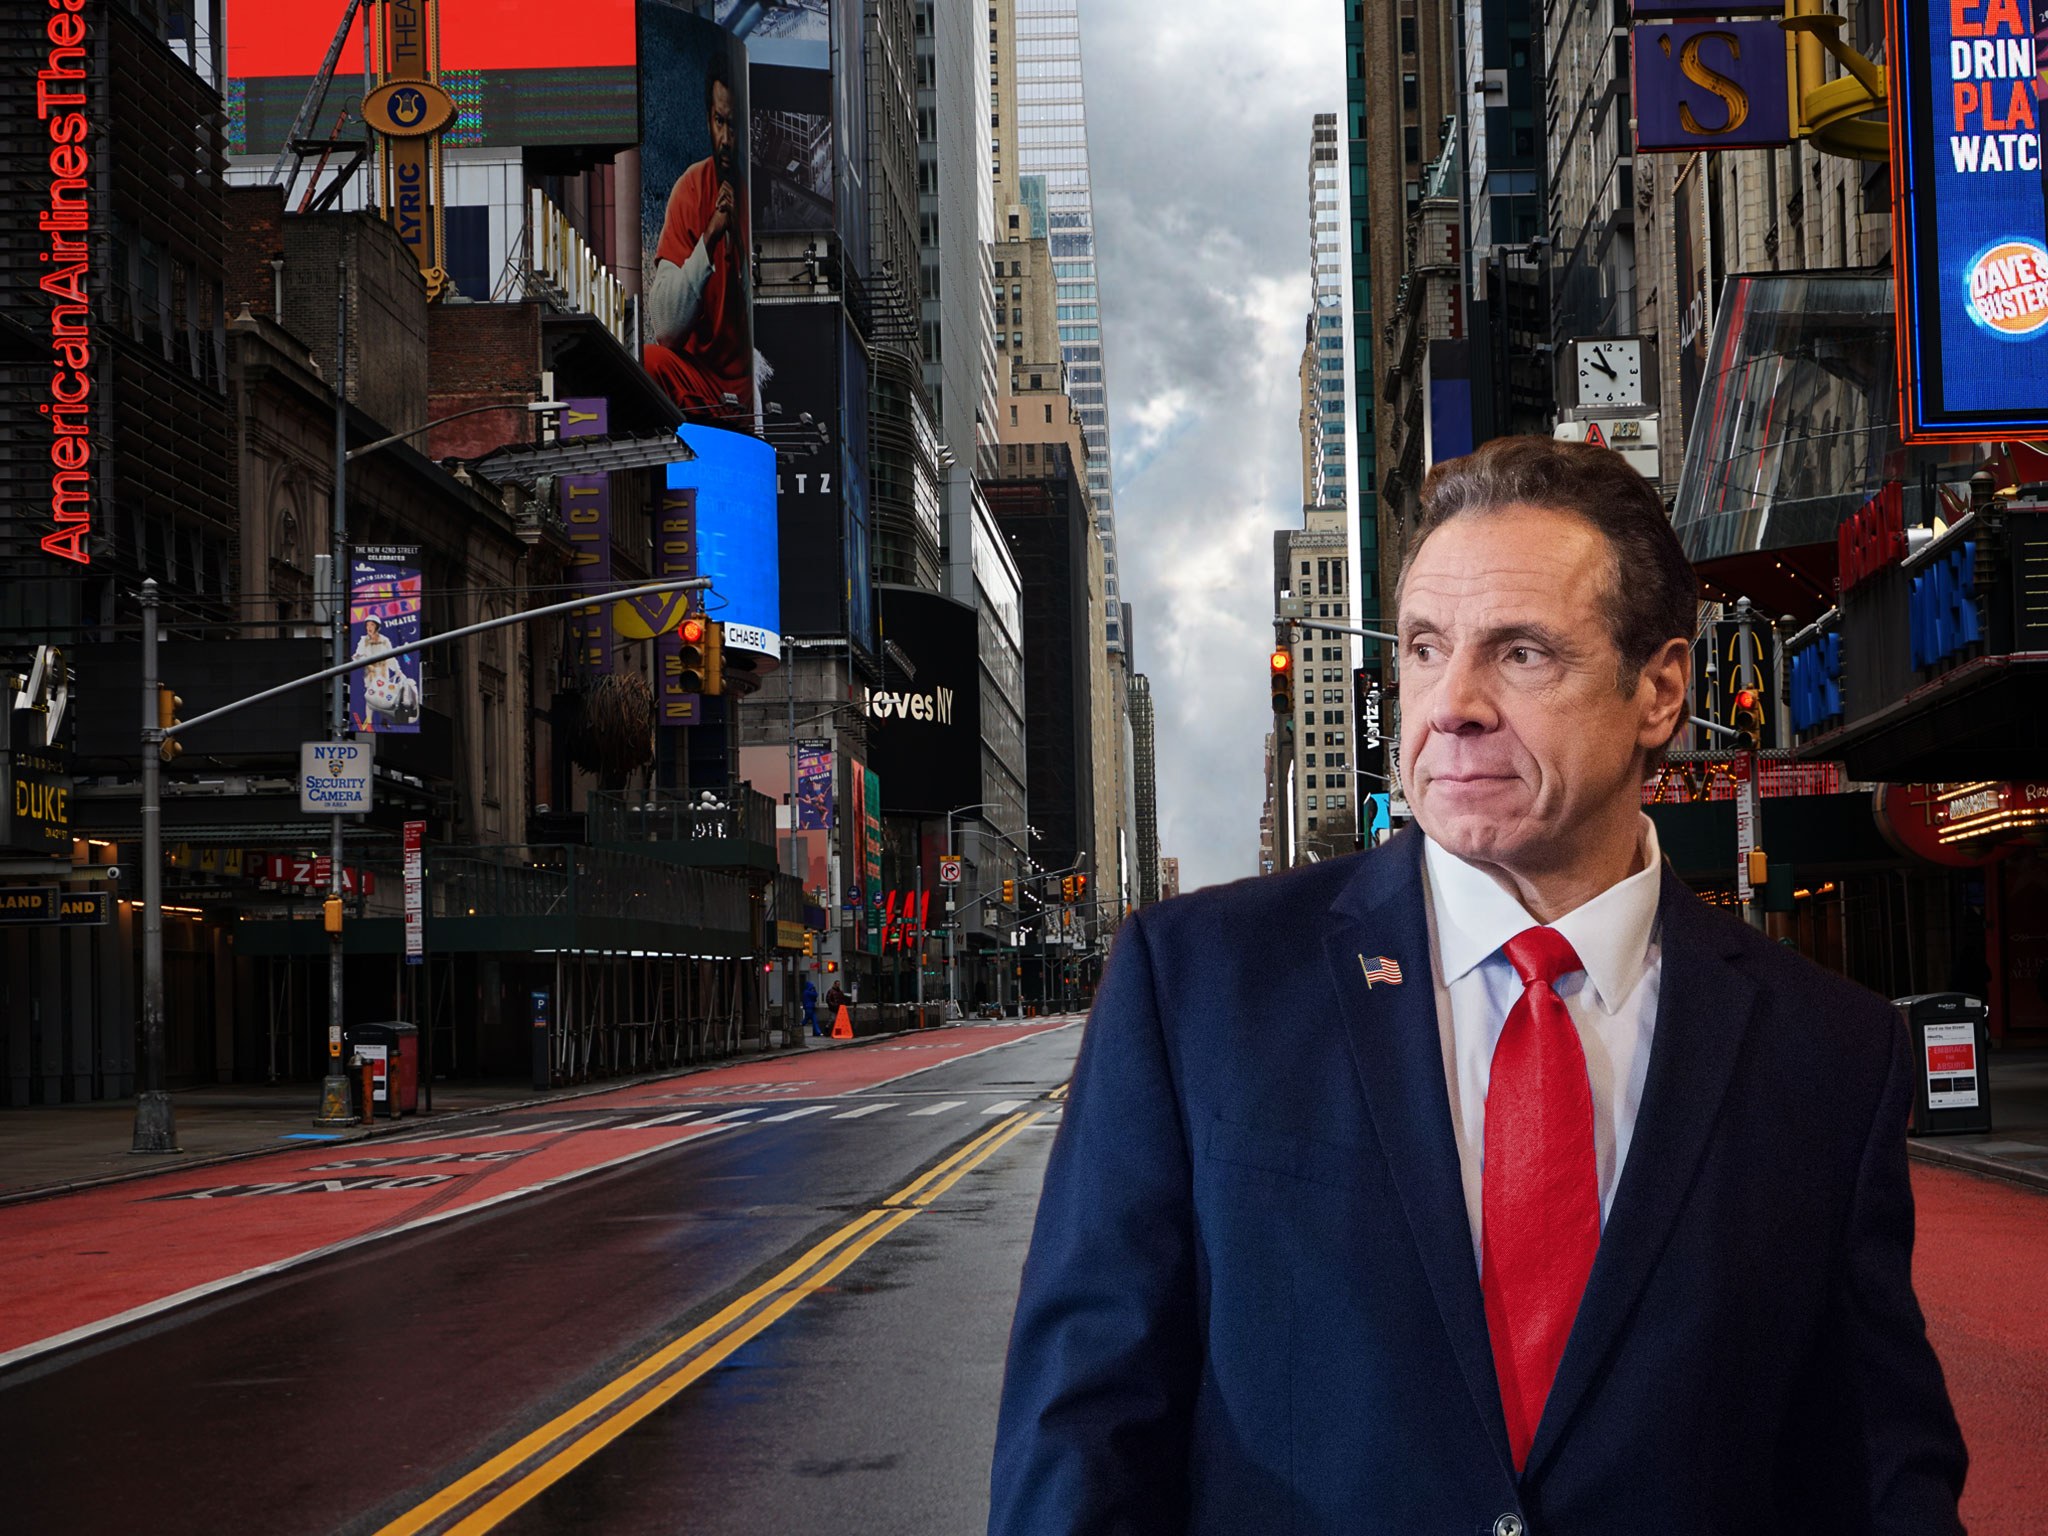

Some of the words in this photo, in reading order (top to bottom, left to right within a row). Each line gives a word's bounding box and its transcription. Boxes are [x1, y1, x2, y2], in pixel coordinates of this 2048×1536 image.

[1951, 0, 2035, 37] EA
[1951, 38, 2036, 79] DRIN
[1953, 80, 2039, 132] PLA
[1950, 133, 2042, 173] WATC
[402, 162, 422, 244] LYRIC
[1974, 254, 2037, 298] DAVE
[1681, 290, 1703, 353] ALDO
[1603, 343, 1613, 352] 12
[355, 546, 366, 554] THE
[367, 546, 380, 554] NEW
[353, 599, 417, 620] VICTORY
[384, 614, 417, 628] THEATER
[729, 627, 759, 642] CHASE
[936, 685, 953, 726] NY
[314, 746, 358, 759] NYPD
[306, 775, 366, 789] SECURITY
[308, 788, 363, 802] CAMERA
[15, 778, 68, 825] DUKE
[247, 854, 366, 893] PIZA!
[1934, 1045, 1967, 1054] EMBRACE
[1936, 1061, 1966, 1070] ABSURD
